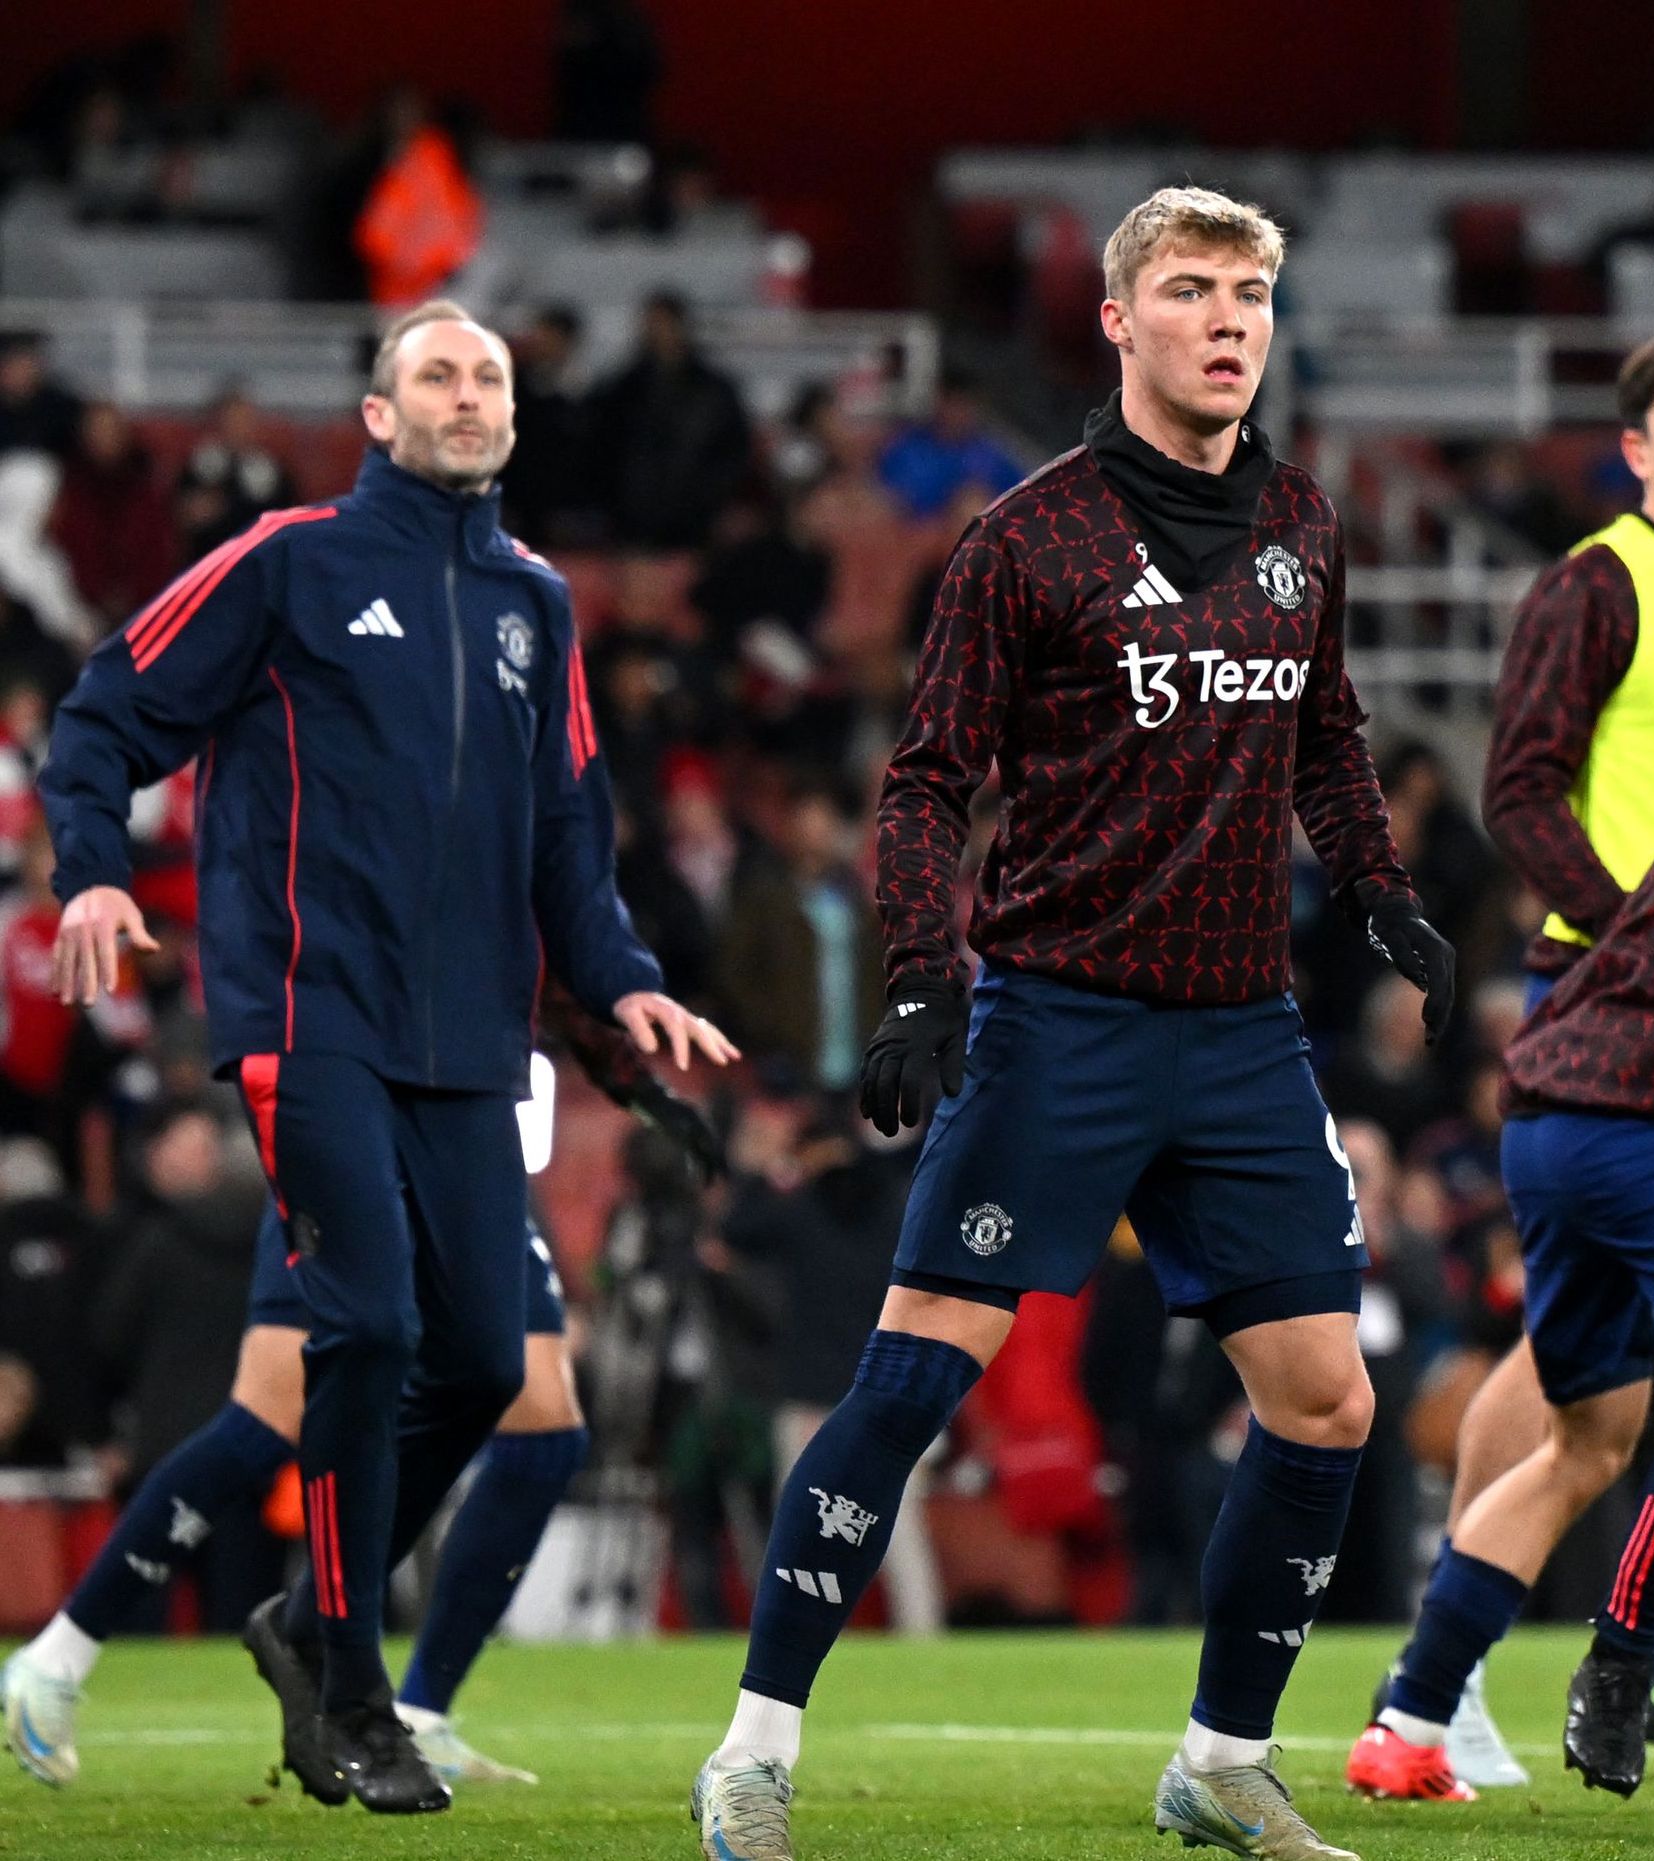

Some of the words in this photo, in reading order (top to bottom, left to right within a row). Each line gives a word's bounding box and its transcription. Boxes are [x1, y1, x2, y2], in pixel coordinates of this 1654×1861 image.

[1135, 542, 1148, 564] 9
[1260, 550, 1298, 571] MANCHESTER
[1273, 593, 1301, 605] UNITED
[968, 1206, 1009, 1228] MANCHESTER
[969, 1239, 998, 1252] UNITED
